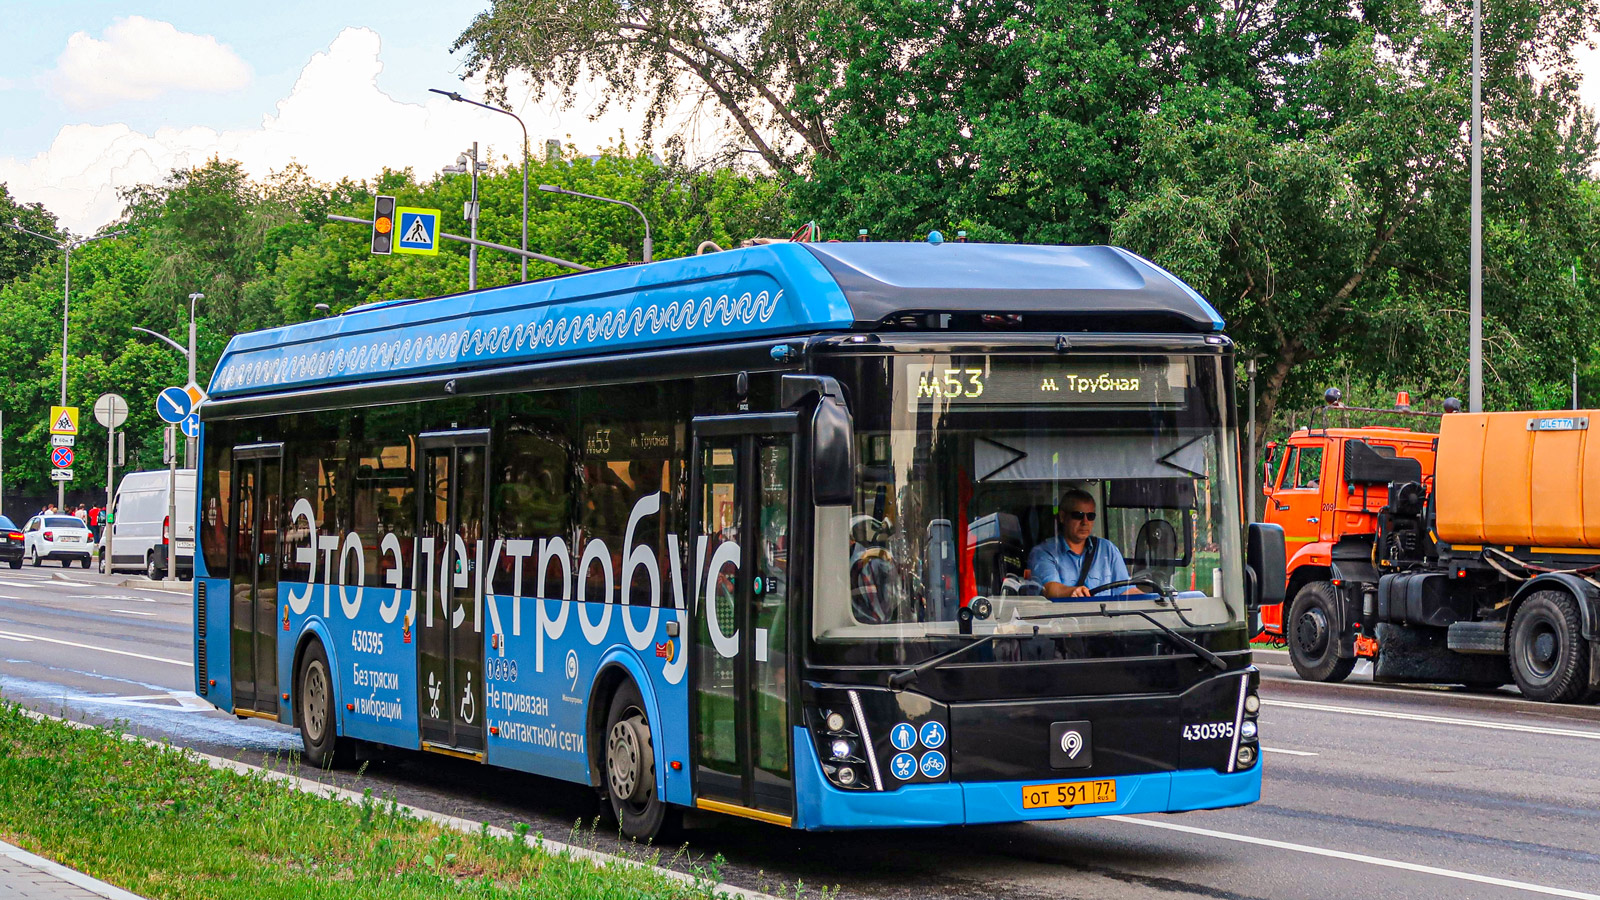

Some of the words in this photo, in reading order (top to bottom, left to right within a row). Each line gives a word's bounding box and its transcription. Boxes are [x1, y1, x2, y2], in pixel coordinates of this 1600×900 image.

[1041, 378, 1059, 391] м.
[1067, 374, 1139, 392] Трубная
[1540, 419, 1573, 429] GILETTA
[288, 498, 364, 619] Это
[379, 490, 768, 685] электробус.
[351, 630, 383, 655] 430395
[353, 663, 368, 687] Без
[369, 670, 399, 692] тряски
[354, 697, 360, 713] и
[360, 693, 402, 722] вибраций
[485, 682, 500, 708] Не
[501, 691, 549, 716] привязан
[498, 720, 558, 749] контактной
[559, 730, 584, 753] сети
[1182, 722, 1234, 741] 430395
[1030, 791, 1049, 805] ОТ
[1057, 784, 1086, 803] 591
[1095, 781, 1110, 796] 77
